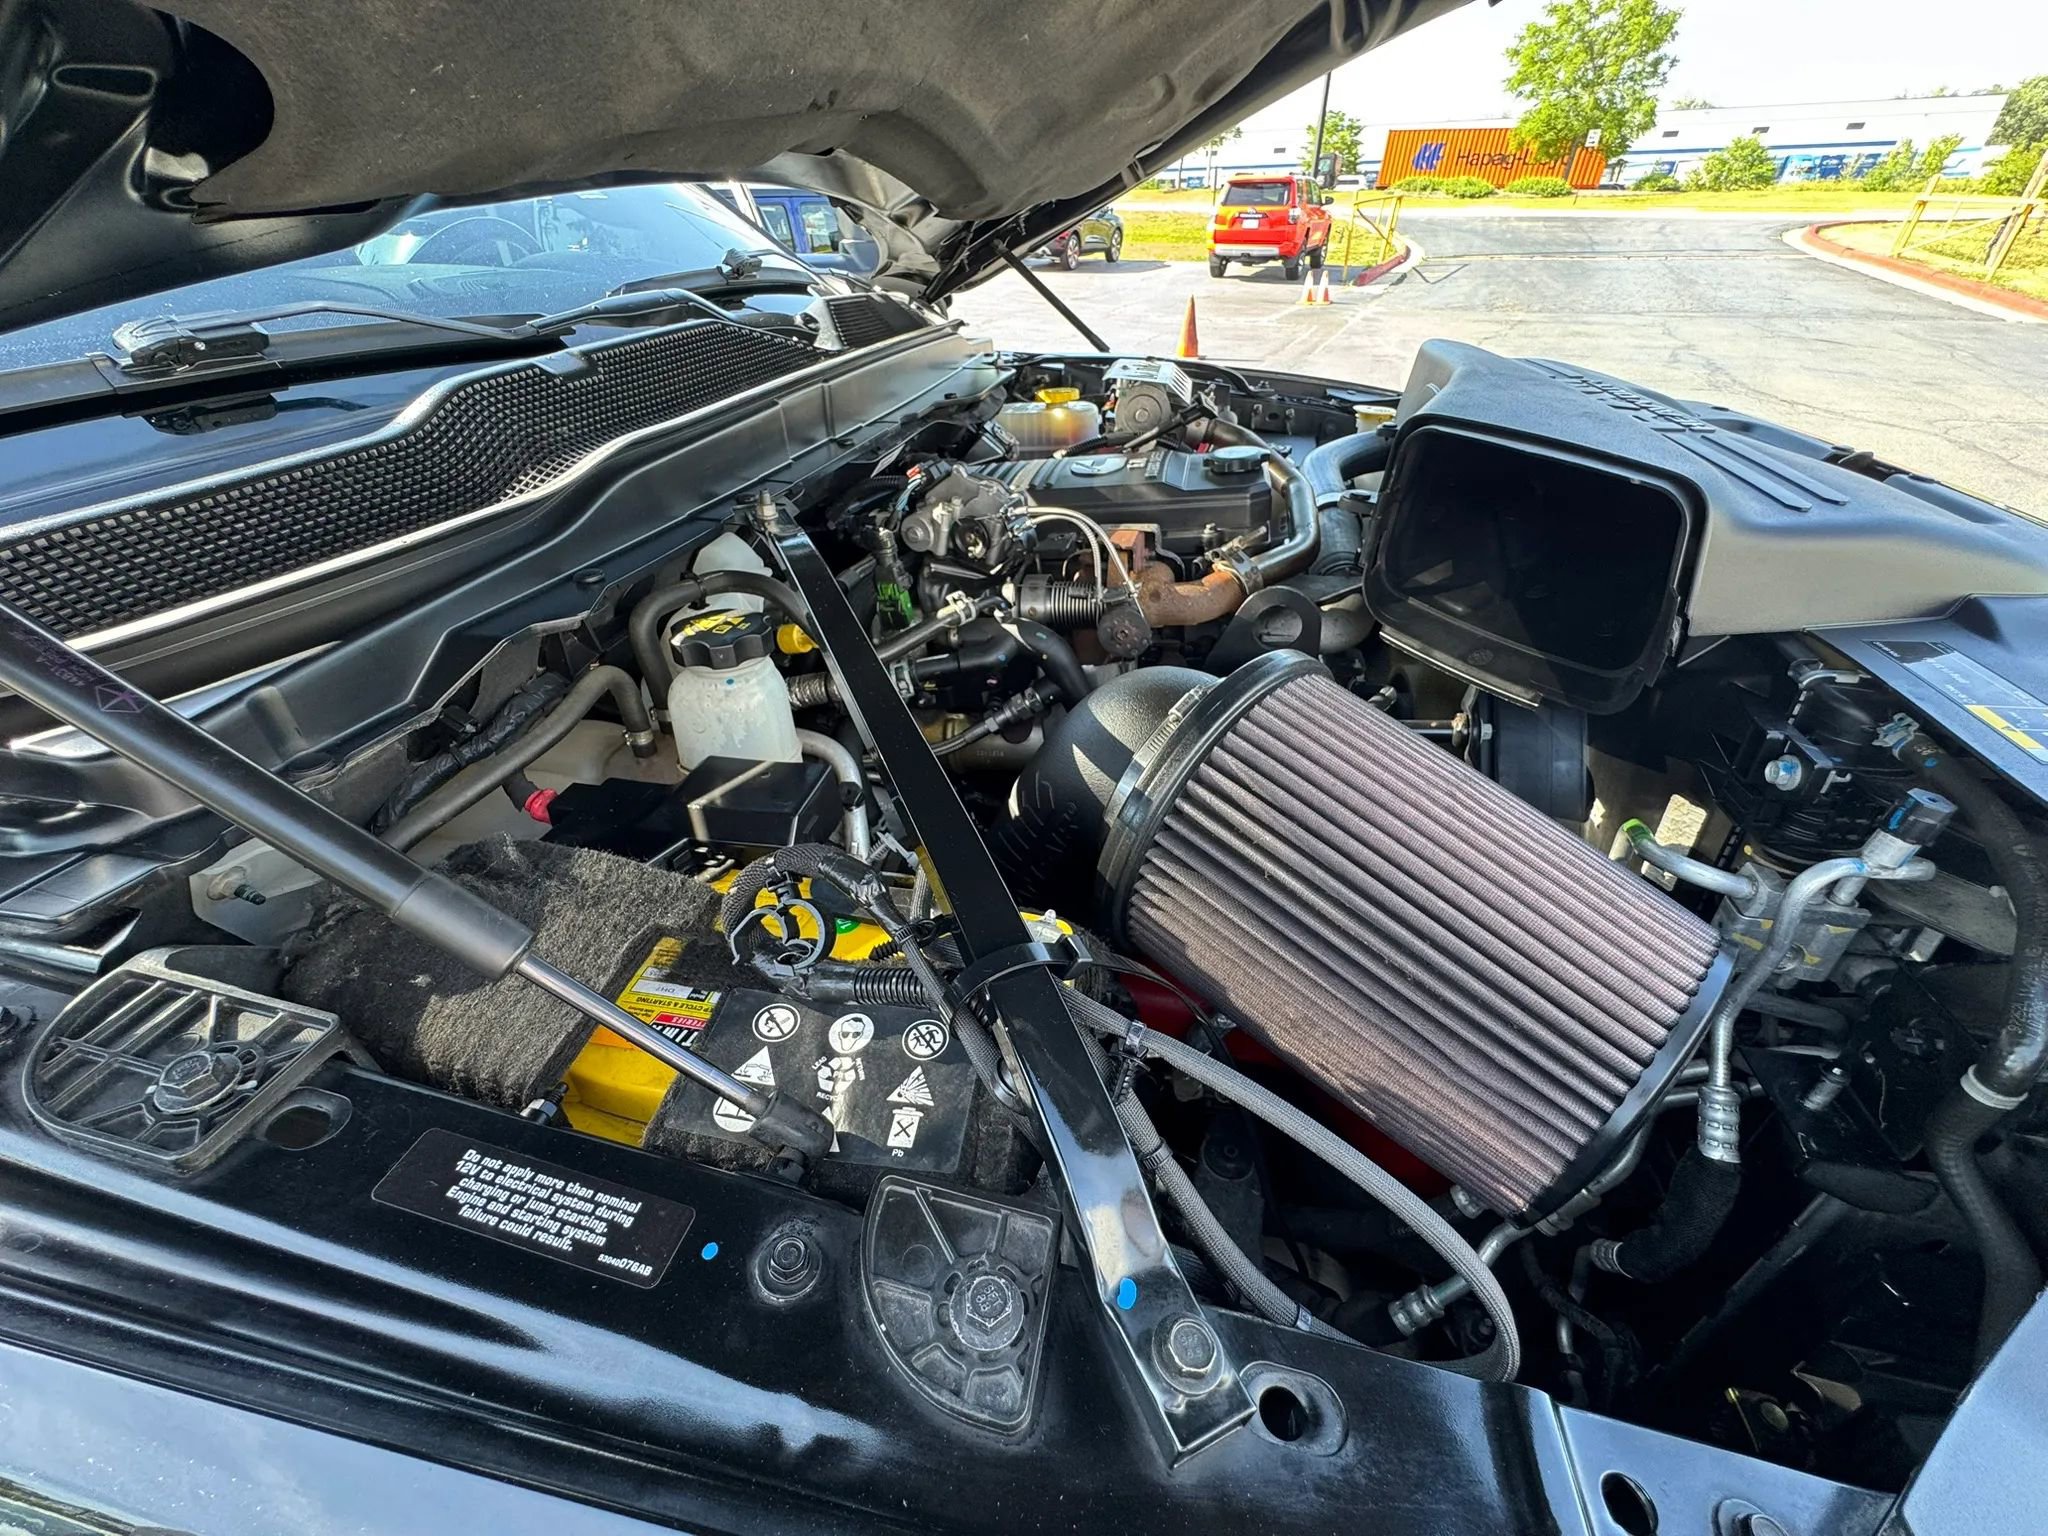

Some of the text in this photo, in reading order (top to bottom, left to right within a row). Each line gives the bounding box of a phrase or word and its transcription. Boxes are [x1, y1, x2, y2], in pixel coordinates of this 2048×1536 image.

[635, 996, 674, 1008] STARTING
[679, 1002, 703, 1011] CYCLE
[891, 1148, 904, 1158] Pb
[455, 1160, 635, 1228] 12V to electrical system during
[458, 1177, 511, 1201] charging
[510, 1192, 527, 1204] or
[524, 1197, 556, 1215] jump
[462, 1149, 643, 1214] Do not apply more than nominal
[446, 1185, 608, 1246] Engine and starting system
[457, 1204, 497, 1226] failure
[498, 1217, 535, 1237] could
